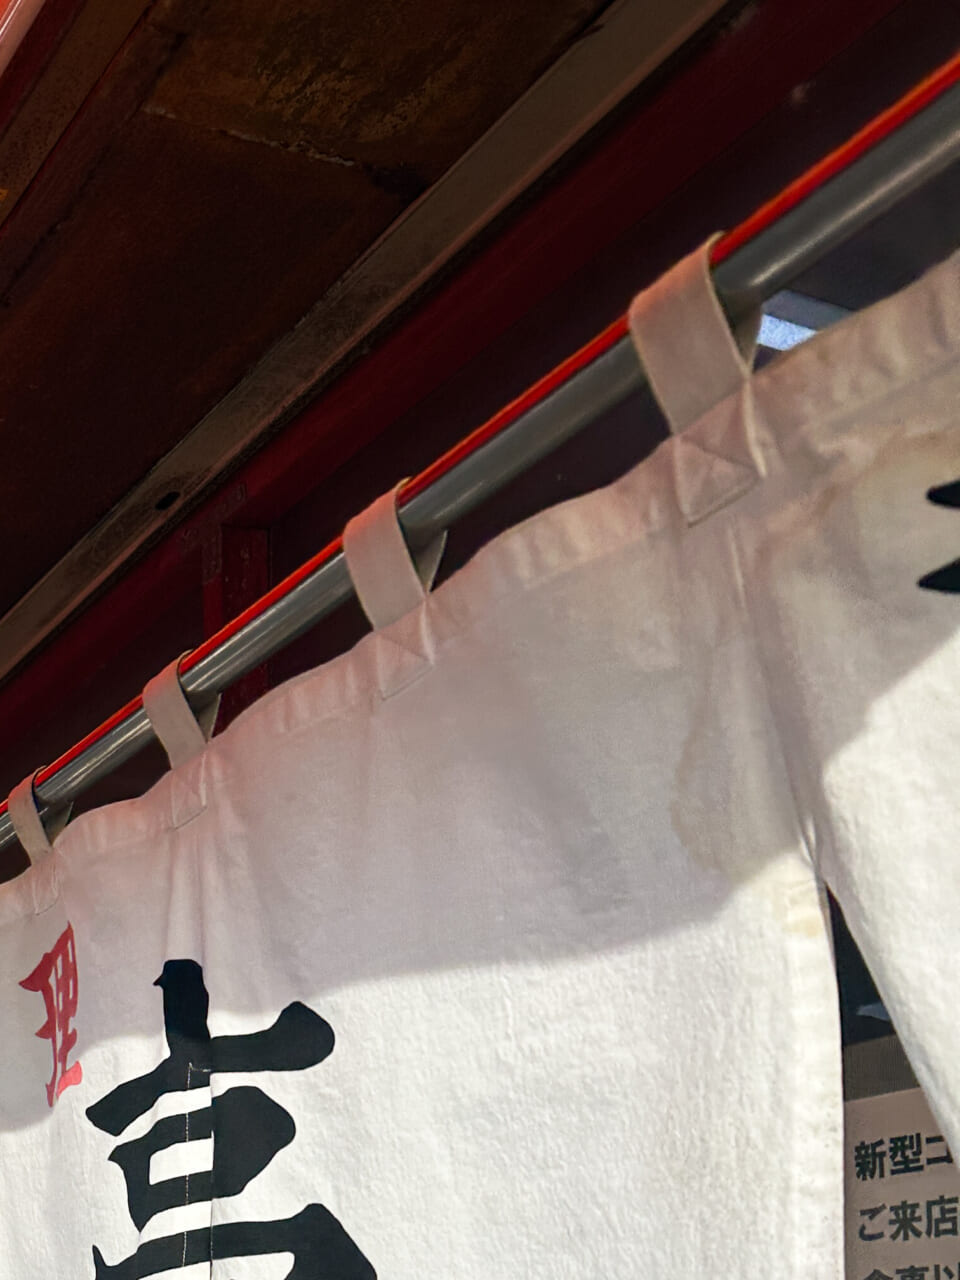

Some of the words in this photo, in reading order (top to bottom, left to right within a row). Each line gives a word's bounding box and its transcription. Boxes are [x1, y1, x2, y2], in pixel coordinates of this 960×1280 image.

[854, 1133, 954, 1181] 新型コ
[858, 1195, 960, 1242] ご来店
